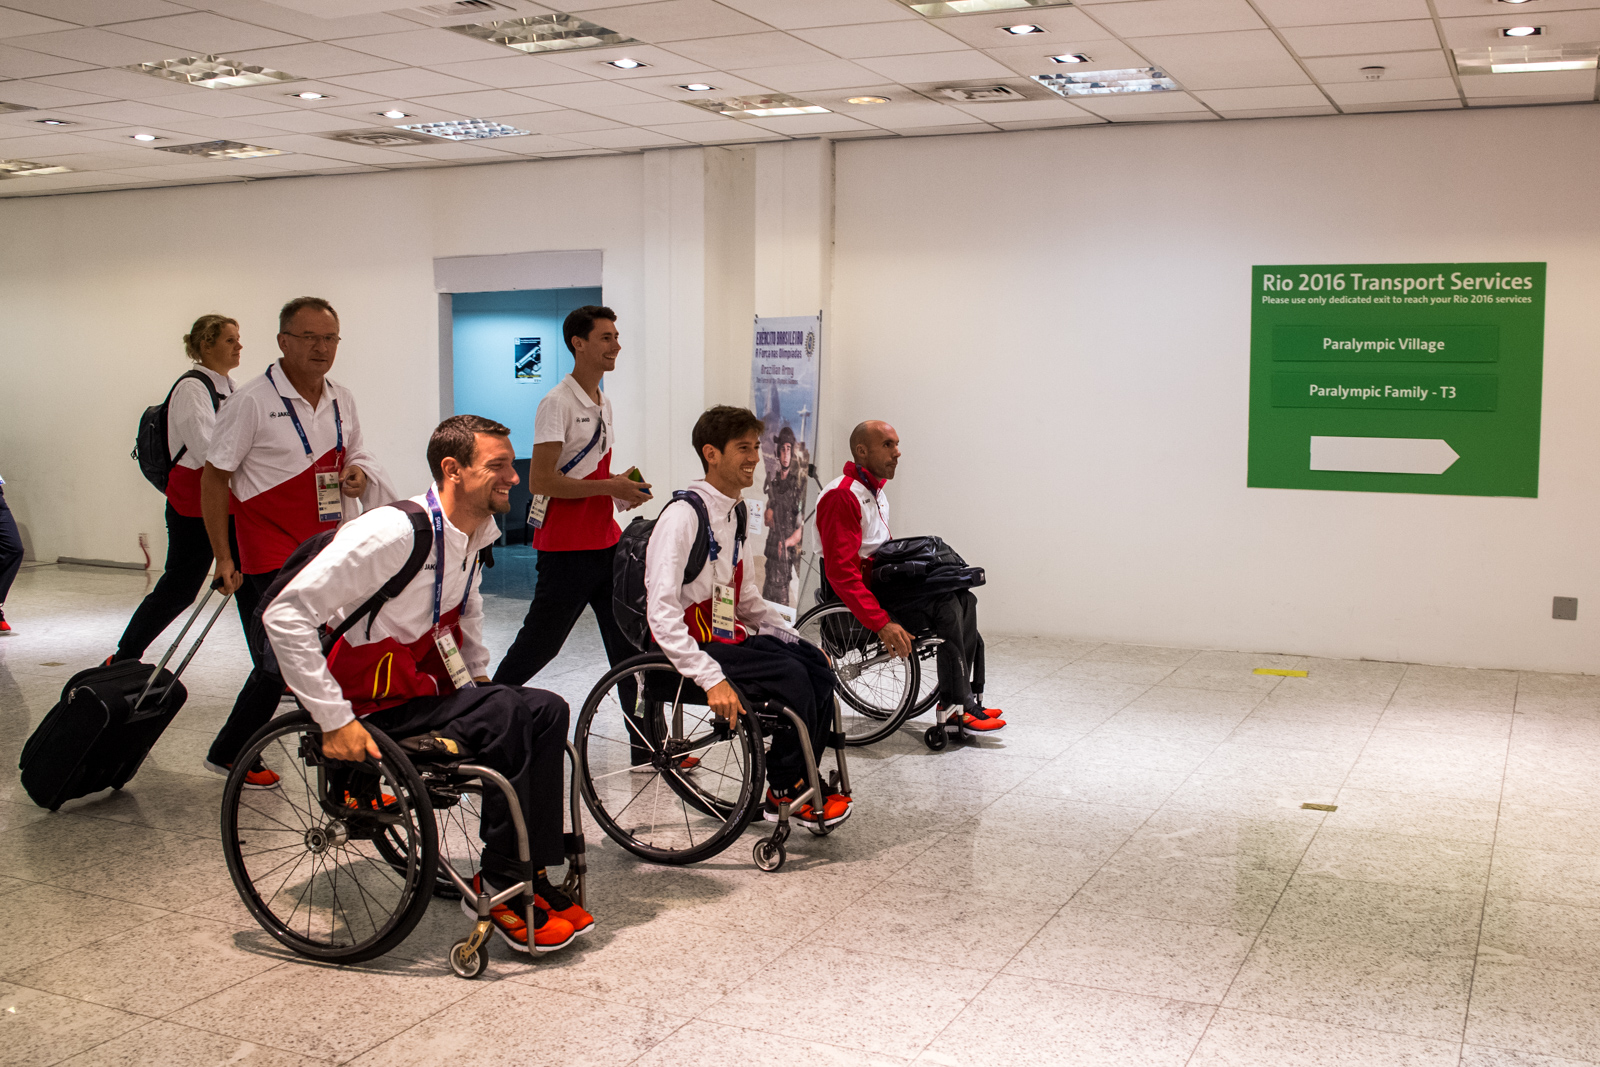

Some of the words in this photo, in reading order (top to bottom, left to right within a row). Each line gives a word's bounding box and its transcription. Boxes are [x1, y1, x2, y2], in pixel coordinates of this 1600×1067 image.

[1263, 274, 1294, 291] Rio
[1298, 273, 1346, 291] 2016
[1350, 273, 1445, 295] Transport
[1450, 272, 1534, 290] Services
[1262, 295, 1290, 304] Please
[1307, 295, 1327, 306] only
[1328, 295, 1372, 304] dedicated
[1373, 295, 1391, 304] exit
[1392, 296, 1402, 304] to
[1404, 294, 1429, 304] reach
[1430, 297, 1452, 306] your
[1453, 294, 1469, 304] Rio
[1470, 294, 1494, 304] 2016
[1495, 294, 1533, 304] services
[1323, 337, 1396, 353] Paralympic
[1398, 337, 1446, 354] Village
[1309, 384, 1382, 400] Paralympic
[1384, 385, 1429, 401] Family
[1439, 386, 1457, 399] T3
